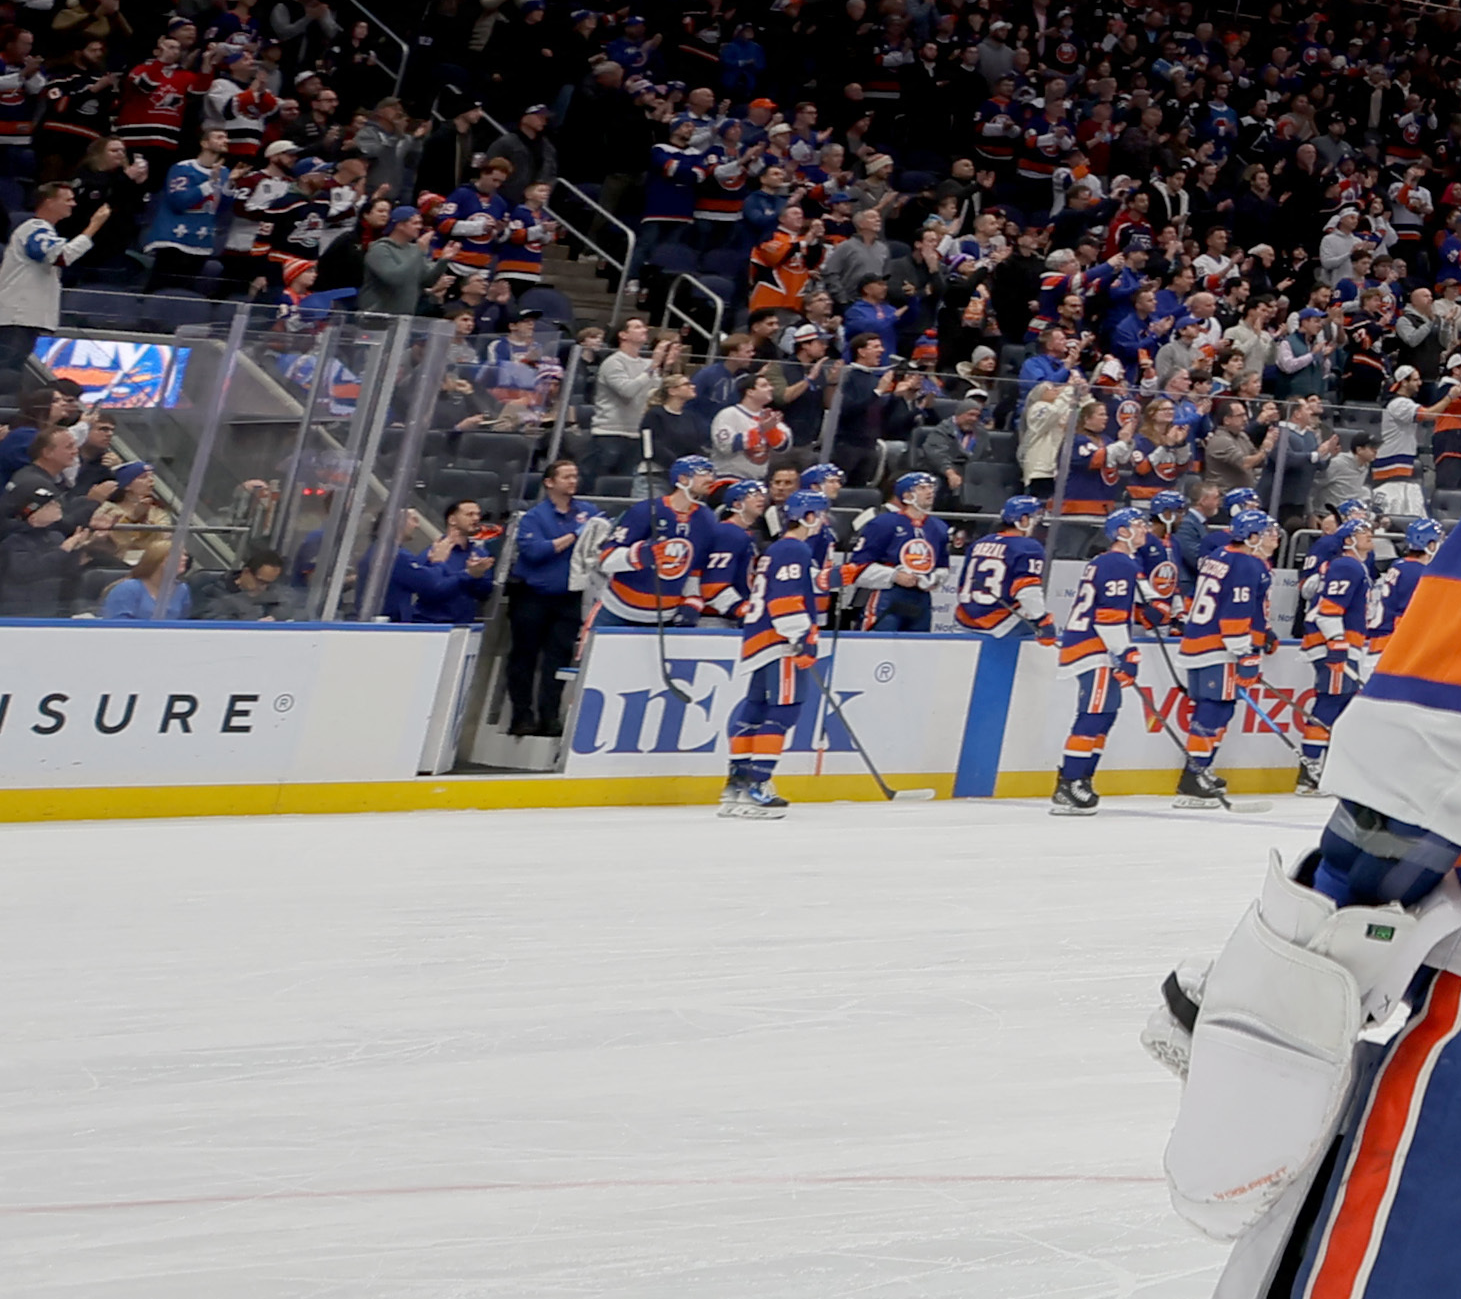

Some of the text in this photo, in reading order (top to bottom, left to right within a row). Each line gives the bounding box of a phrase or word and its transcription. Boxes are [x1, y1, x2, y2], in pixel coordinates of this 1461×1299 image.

[709, 552, 730, 569] 77
[1028, 558, 1043, 575] 13
[959, 558, 1003, 605] 13
[1104, 579, 1129, 597] 32
[1327, 580, 1351, 596] 27
[1233, 586, 1250, 603] 16
